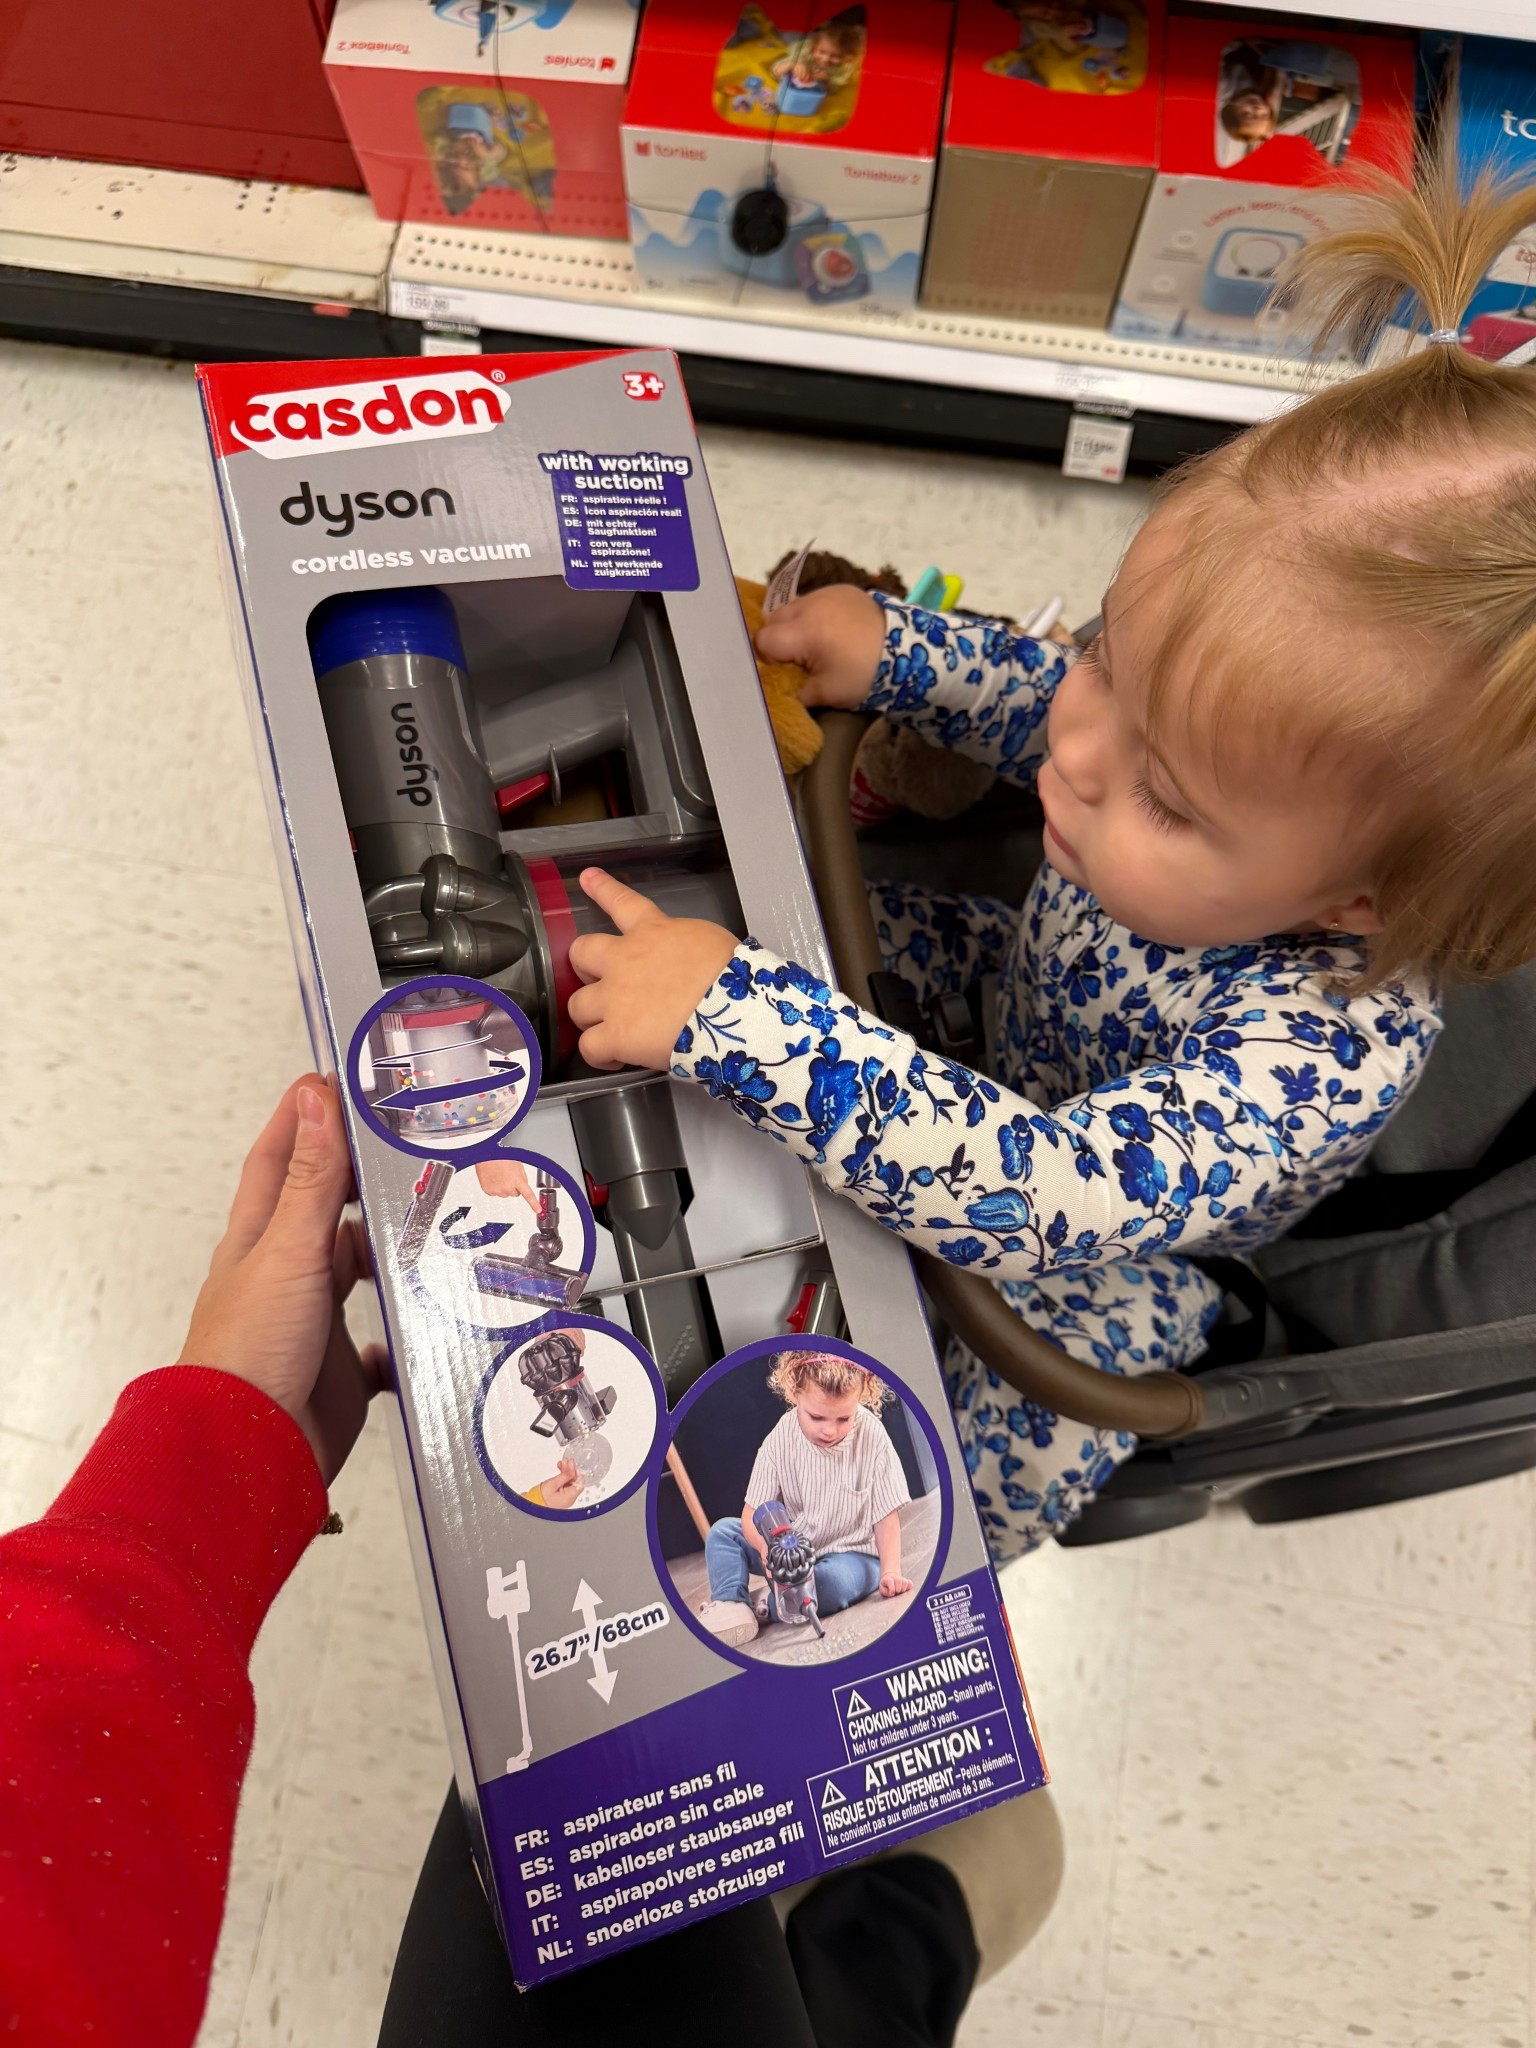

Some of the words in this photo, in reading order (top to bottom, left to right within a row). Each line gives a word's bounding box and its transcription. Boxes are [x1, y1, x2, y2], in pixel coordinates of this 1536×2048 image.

[624, 374, 664, 397] 3+
[542, 454, 594, 470] with
[598, 455, 689, 475] working
[575, 474, 664, 490] suction!
[280, 481, 456, 538] dyson
[560, 494, 578, 503] FR:
[582, 495, 632, 506] aspiration
[634, 496, 662, 504] réelle
[608, 506, 658, 518] aspiración
[660, 508, 682, 517] real!
[586, 520, 604, 528] mit
[606, 520, 638, 528] echter
[588, 528, 657, 538] Saugfunktion!
[290, 548, 414, 576] cordless
[420, 542, 532, 565] vacuum
[568, 540, 581, 548] IT:
[591, 548, 651, 557] aspirazione!
[570, 560, 588, 568] NL:
[592, 560, 613, 568] met
[615, 560, 663, 569] werkende
[594, 569, 650, 578] zuigkracht!
[390, 702, 439, 807] dyson
[538, 1291, 562, 1303] dyson
[944, 1593, 954, 1602] AA
[886, 1647, 990, 1702] WARNING:
[848, 1708, 901, 1740] CHOKING
[901, 1690, 947, 1721] HAZARD
[974, 1680, 996, 1698] parts.
[852, 1741, 868, 1757] Not
[868, 1736, 878, 1750] for
[880, 1728, 909, 1747] children
[910, 1720, 930, 1738] under
[930, 1715, 936, 1726] 3
[936, 1710, 960, 1727] years.
[864, 1725, 982, 1792] ATTENTION
[514, 1828, 550, 1853] FR:
[563, 1788, 664, 1837] aspirateur
[668, 1772, 713, 1800] sans
[716, 1760, 737, 1784] fil
[822, 1801, 865, 1832] RISQUE
[866, 1766, 954, 1817] D'ÉTOUFFEMENT
[982, 1752, 1016, 1773] éléments.
[827, 1834, 839, 1848] Ne
[840, 1820, 872, 1841] convient
[872, 1818, 886, 1834] pas
[887, 1812, 901, 1824] aux
[901, 1801, 929, 1820] enfants
[930, 1797, 939, 1810] de
[940, 1789, 962, 1806] moins
[962, 1784, 972, 1797] de
[972, 1782, 978, 1793] 3
[978, 1776, 994, 1792] ans.
[520, 1856, 555, 1881] ES:
[568, 1816, 676, 1864] aspiradora
[679, 1803, 708, 1825] sin
[712, 1780, 765, 1813] cable
[526, 1882, 563, 1909] DE:
[574, 1842, 675, 1892] kabelloser
[679, 1800, 795, 1853] staubsauger
[530, 1912, 560, 1937] IT:
[580, 1859, 717, 1919] aspirapolvere
[720, 1836, 776, 1868] senza
[779, 1820, 806, 1845] fili
[536, 1938, 574, 1965] NL:
[586, 1898, 684, 1948] snoerloze
[688, 1860, 786, 1910] stofzuiger
